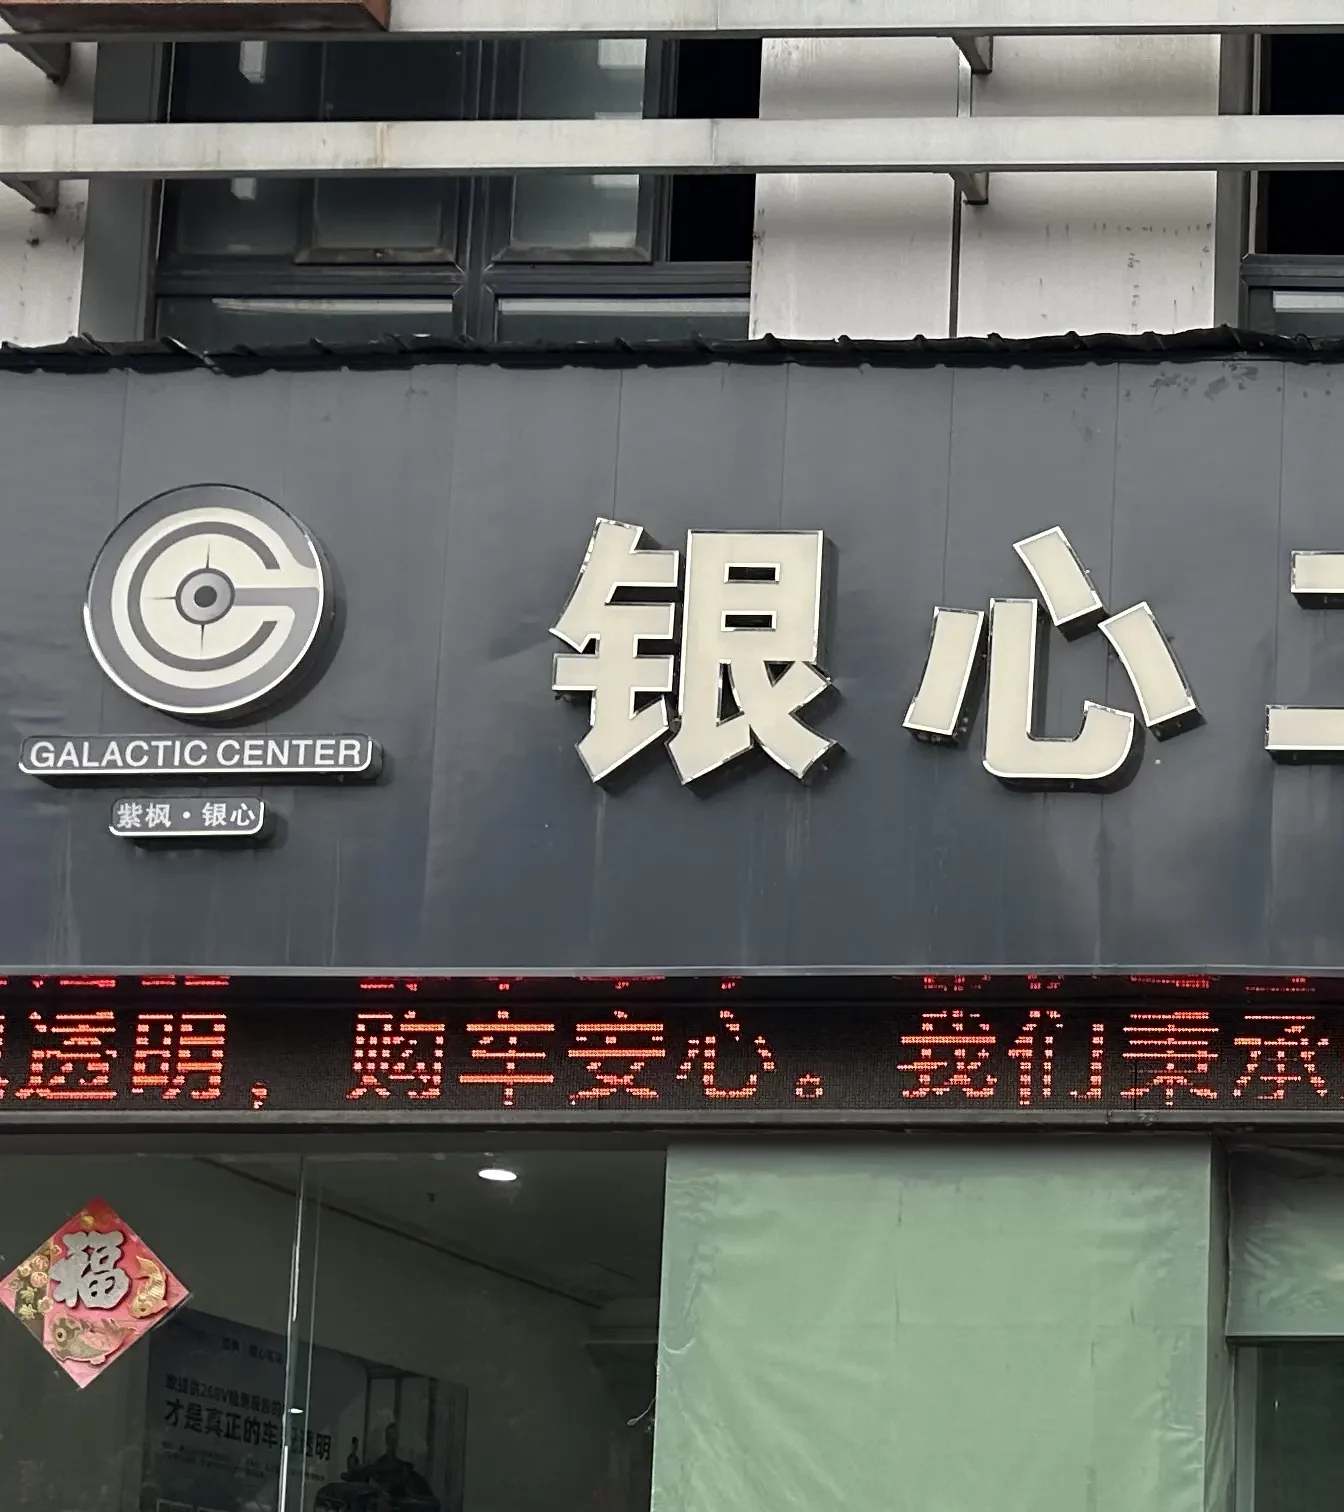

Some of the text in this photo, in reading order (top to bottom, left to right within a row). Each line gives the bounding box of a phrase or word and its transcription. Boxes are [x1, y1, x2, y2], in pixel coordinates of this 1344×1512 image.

[30, 740, 362, 768] GALACTIC CENTER
[116, 801, 256, 829] 紫枫·银心
[51, 1230, 132, 1309] 福
